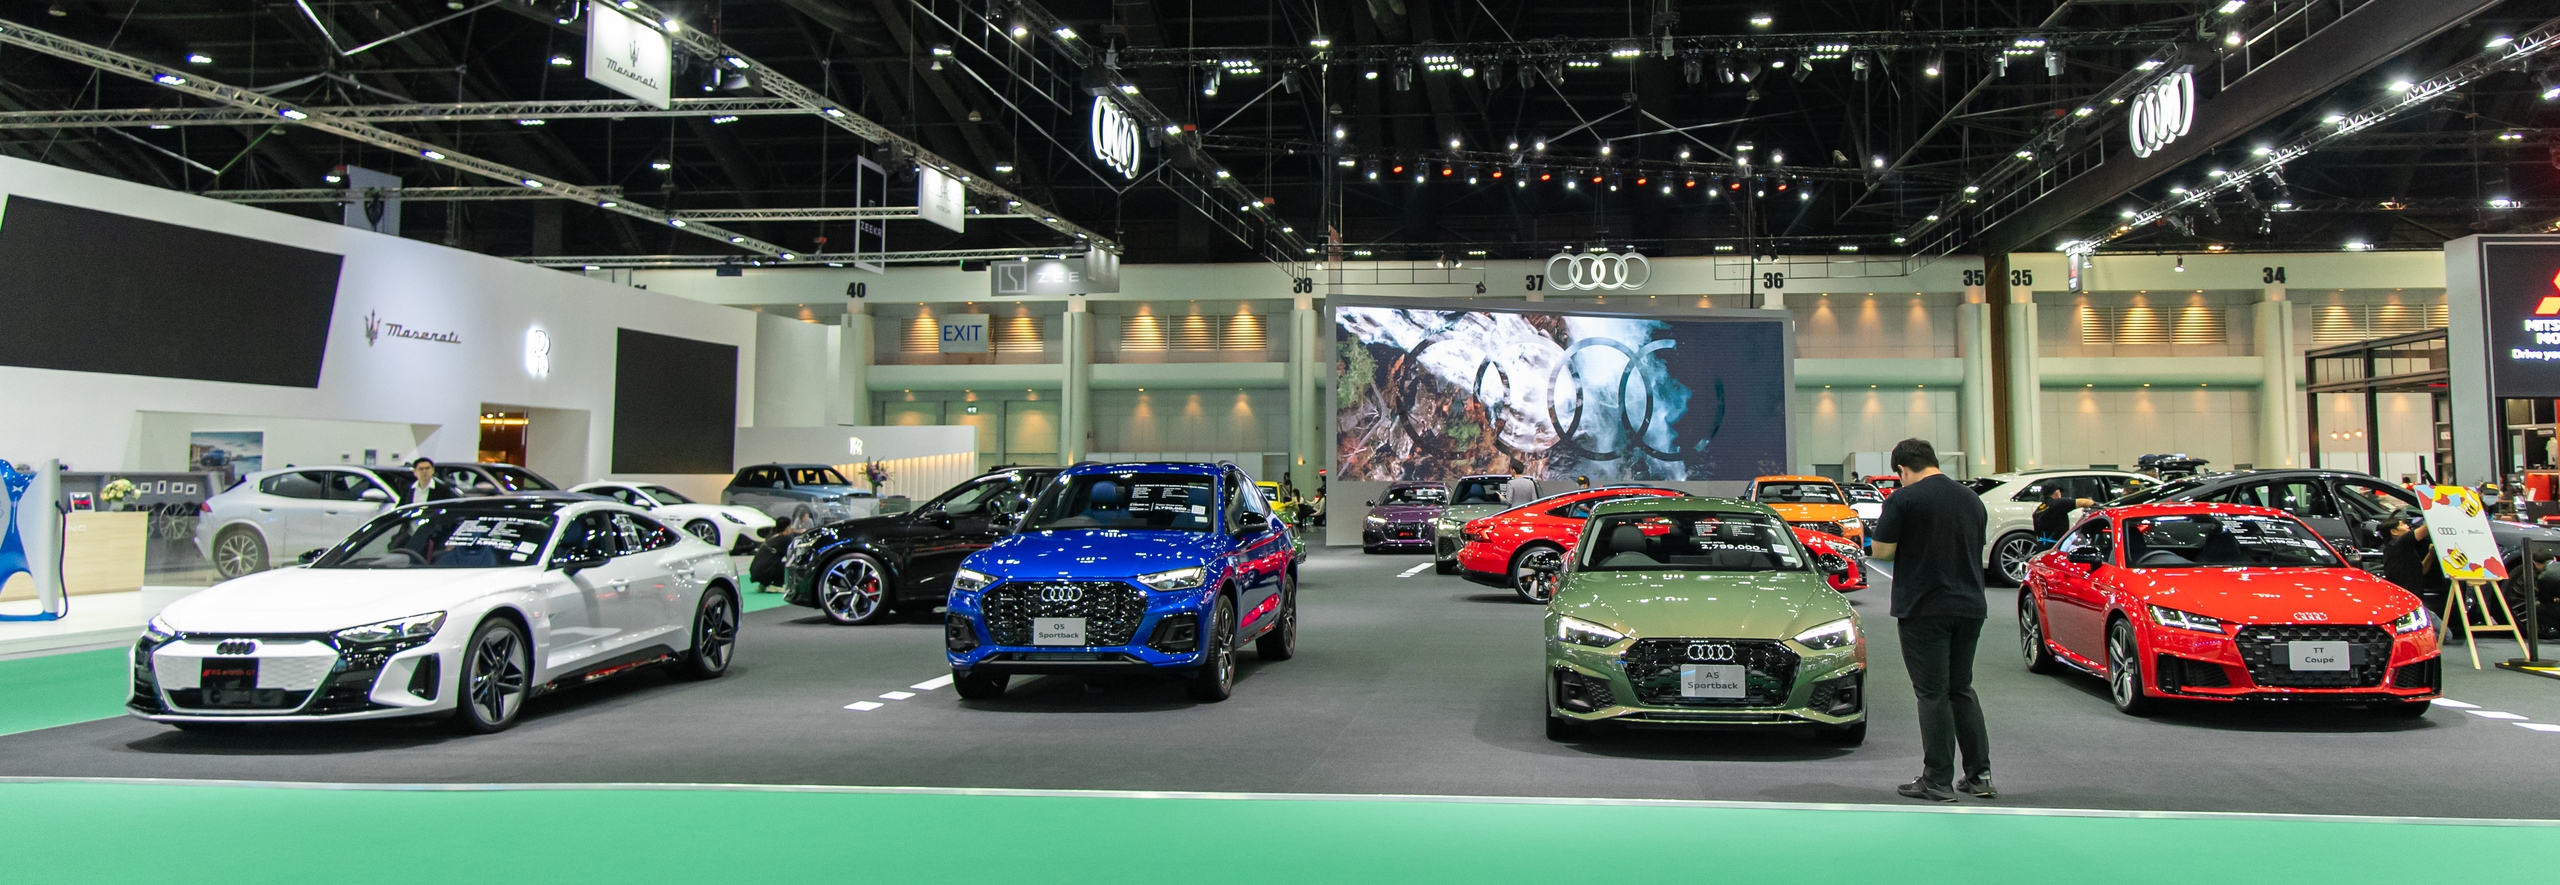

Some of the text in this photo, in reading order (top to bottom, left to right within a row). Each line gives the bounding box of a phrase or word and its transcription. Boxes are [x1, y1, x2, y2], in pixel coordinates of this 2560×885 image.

[606, 57, 658, 90] Maserati
[860, 221, 882, 238] ZEEKR
[1037, 271, 1080, 283] ZEE
[1525, 275, 1544, 291] 37
[1763, 272, 1784, 289] 36
[1963, 269, 1985, 287] 35
[2011, 269, 2033, 287] 35
[2263, 266, 2286, 284] 34
[846, 282, 866, 298] 40
[1293, 277, 1313, 294] 38
[386, 323, 461, 344] Maserati
[943, 324, 982, 342] EXIT
[2511, 348, 2543, 359] Drive
[1038, 631, 1079, 639] Sportback
[1705, 671, 1720, 679] A5
[1687, 681, 1738, 690] Sportback
